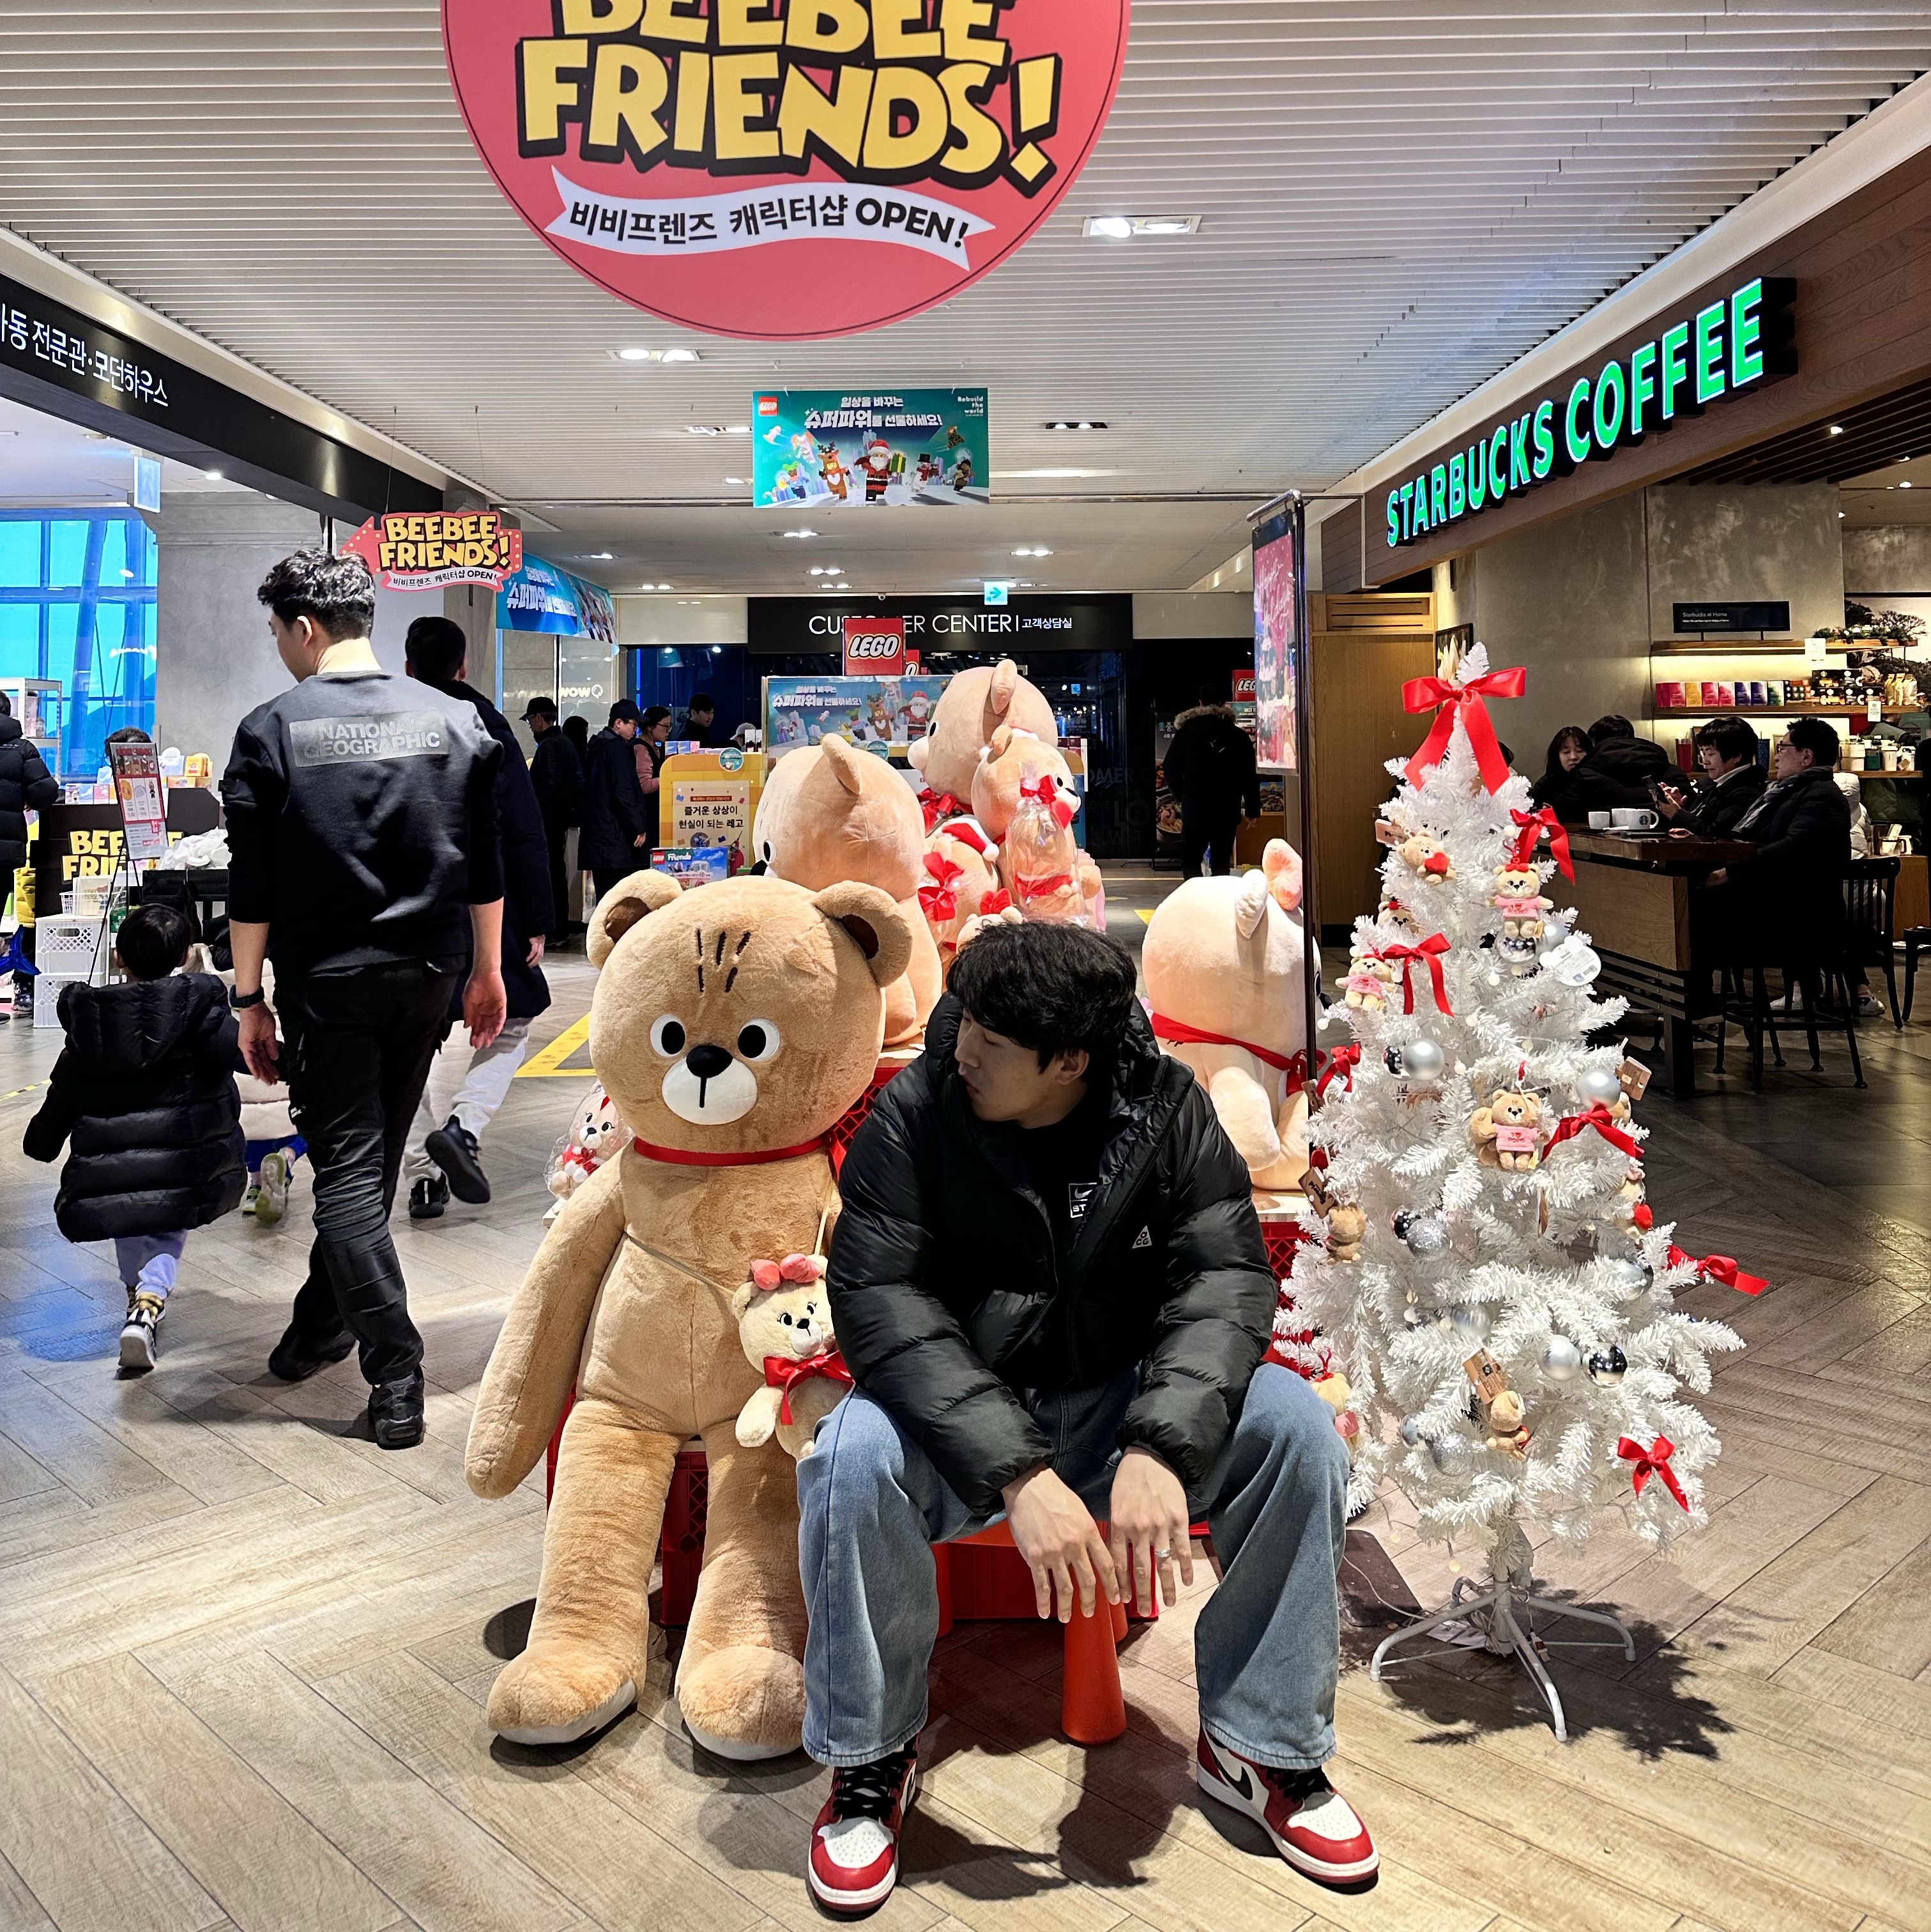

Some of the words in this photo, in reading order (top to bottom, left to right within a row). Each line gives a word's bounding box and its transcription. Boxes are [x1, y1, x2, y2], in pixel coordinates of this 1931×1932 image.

[520, 38, 1060, 192] FRIENDS!
[569, 201, 717, 244] 비비프렌즈
[730, 194, 848, 236] 캐릭터샵
[855, 197, 970, 249] OPEN!
[32, 320, 169, 407] 전문관·모던하우스
[873, 396, 904, 407] 바꾸는
[1387, 399, 1553, 548] STARBUCKS
[1566, 277, 1764, 463] COFFEE
[885, 414, 943, 427] 선물하세요!
[385, 515, 498, 542] BEEBEE
[378, 533, 511, 570] FRIENDS!
[393, 578, 432, 586] 비비프렌즈
[434, 570, 466, 582] 캐릭터샵
[467, 570, 496, 581] OPEN!
[809, 615, 925, 634] CUER
[932, 614, 1012, 634] CENTER
[1022, 617, 1073, 630] 고객상담실
[849, 635, 899, 659] LEGO
[1237, 678, 1256, 692] LEG
[320, 718, 423, 740] NATIONAL
[304, 732, 440, 758] GEOGRAPHIC
[684, 806, 710, 816] 즐거운
[712, 805, 738, 815] 상상이
[678, 819, 704, 829] 현실이
[706, 819, 724, 829] 되는
[726, 819, 744, 829] 레고
[70, 830, 183, 856] BEEE
